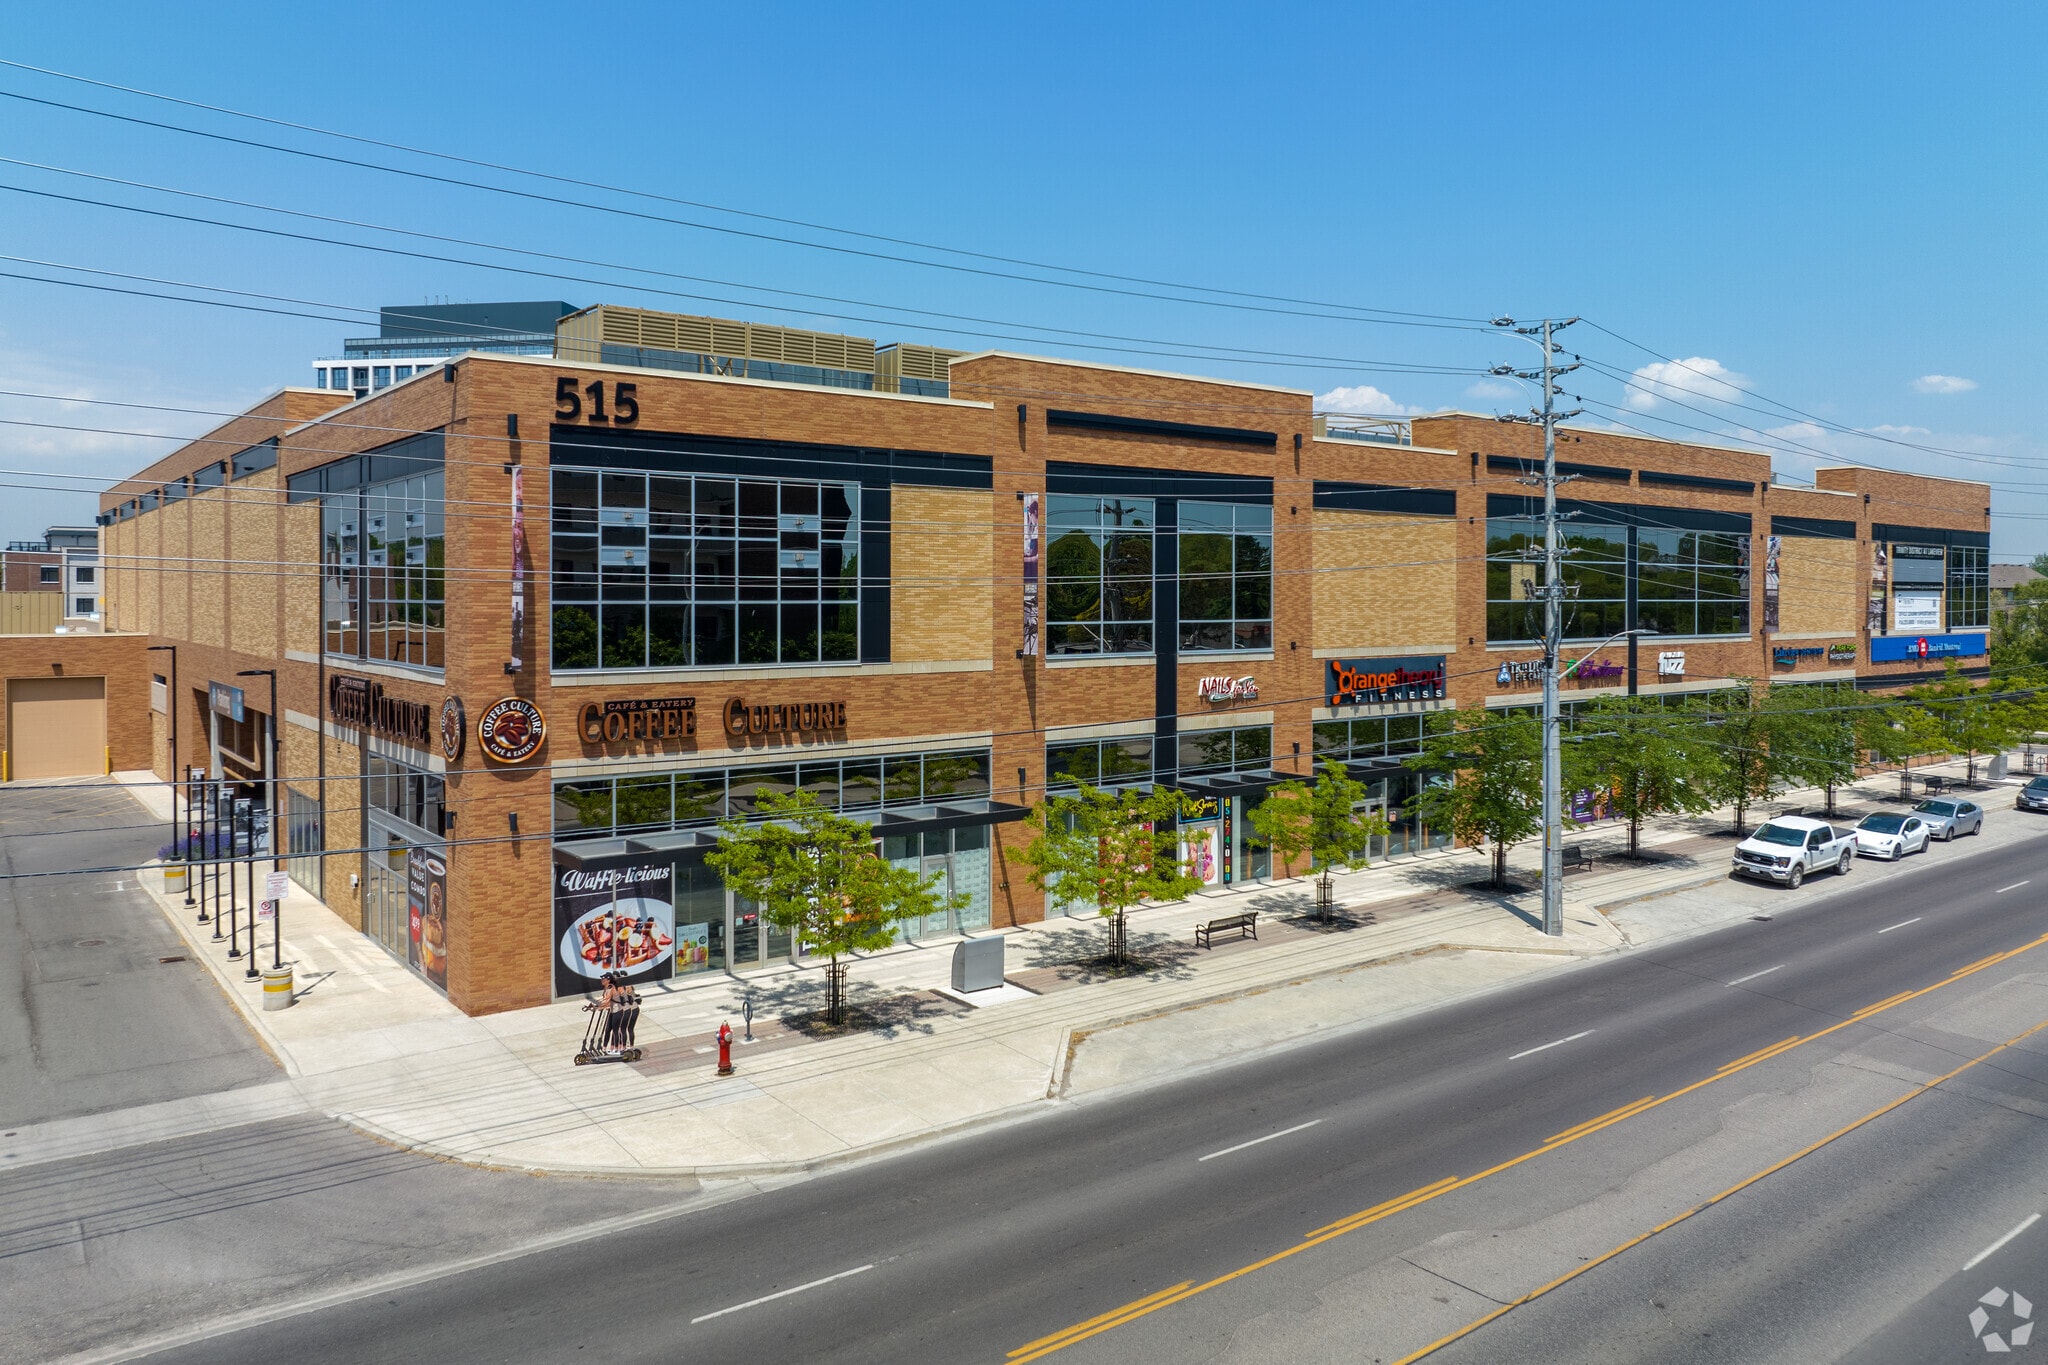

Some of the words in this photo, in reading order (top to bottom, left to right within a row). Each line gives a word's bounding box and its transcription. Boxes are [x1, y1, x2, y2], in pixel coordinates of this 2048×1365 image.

[555, 377, 639, 424] 515
[1199, 677, 1231, 695] NAILS
[1355, 690, 1443, 703] FITNESS
[370, 683, 427, 744] CULTURE
[607, 701, 636, 711] CAFÉ
[651, 699, 694, 709] EATERY
[483, 703, 509, 738] COFFEE
[510, 701, 542, 735] CULTURE
[577, 702, 697, 744] COFFEE
[723, 697, 848, 736] CULTURE
[490, 743, 505, 756] CAFÉ
[513, 742, 535, 757] EATERY
[561, 864, 670, 892] Waffle-licious
